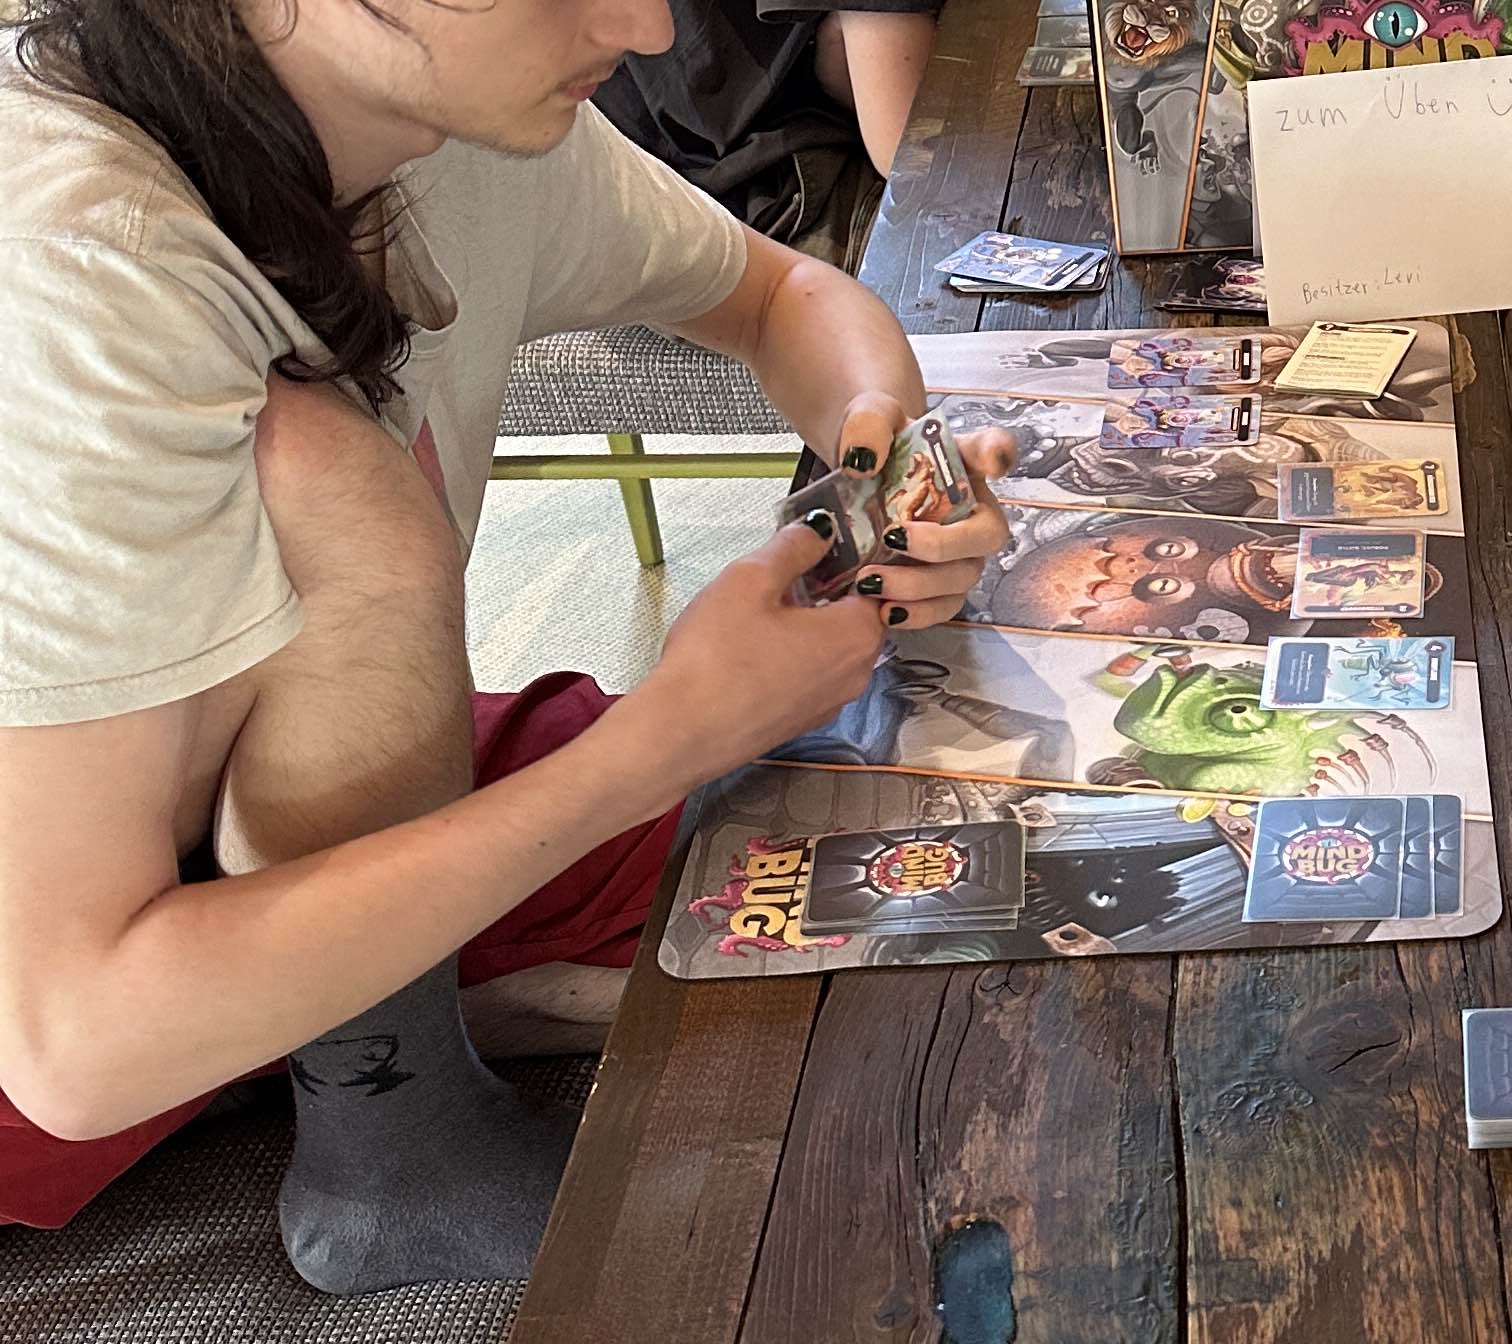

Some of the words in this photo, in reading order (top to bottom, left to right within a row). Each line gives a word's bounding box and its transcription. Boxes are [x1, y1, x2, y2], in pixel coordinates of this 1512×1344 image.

[899, 845, 926, 890] MIND
[923, 846, 948, 890] BUG
[1292, 844, 1369, 860] MIND
[1297, 858, 1360, 875] BUG
[729, 848, 804, 939] BUG
